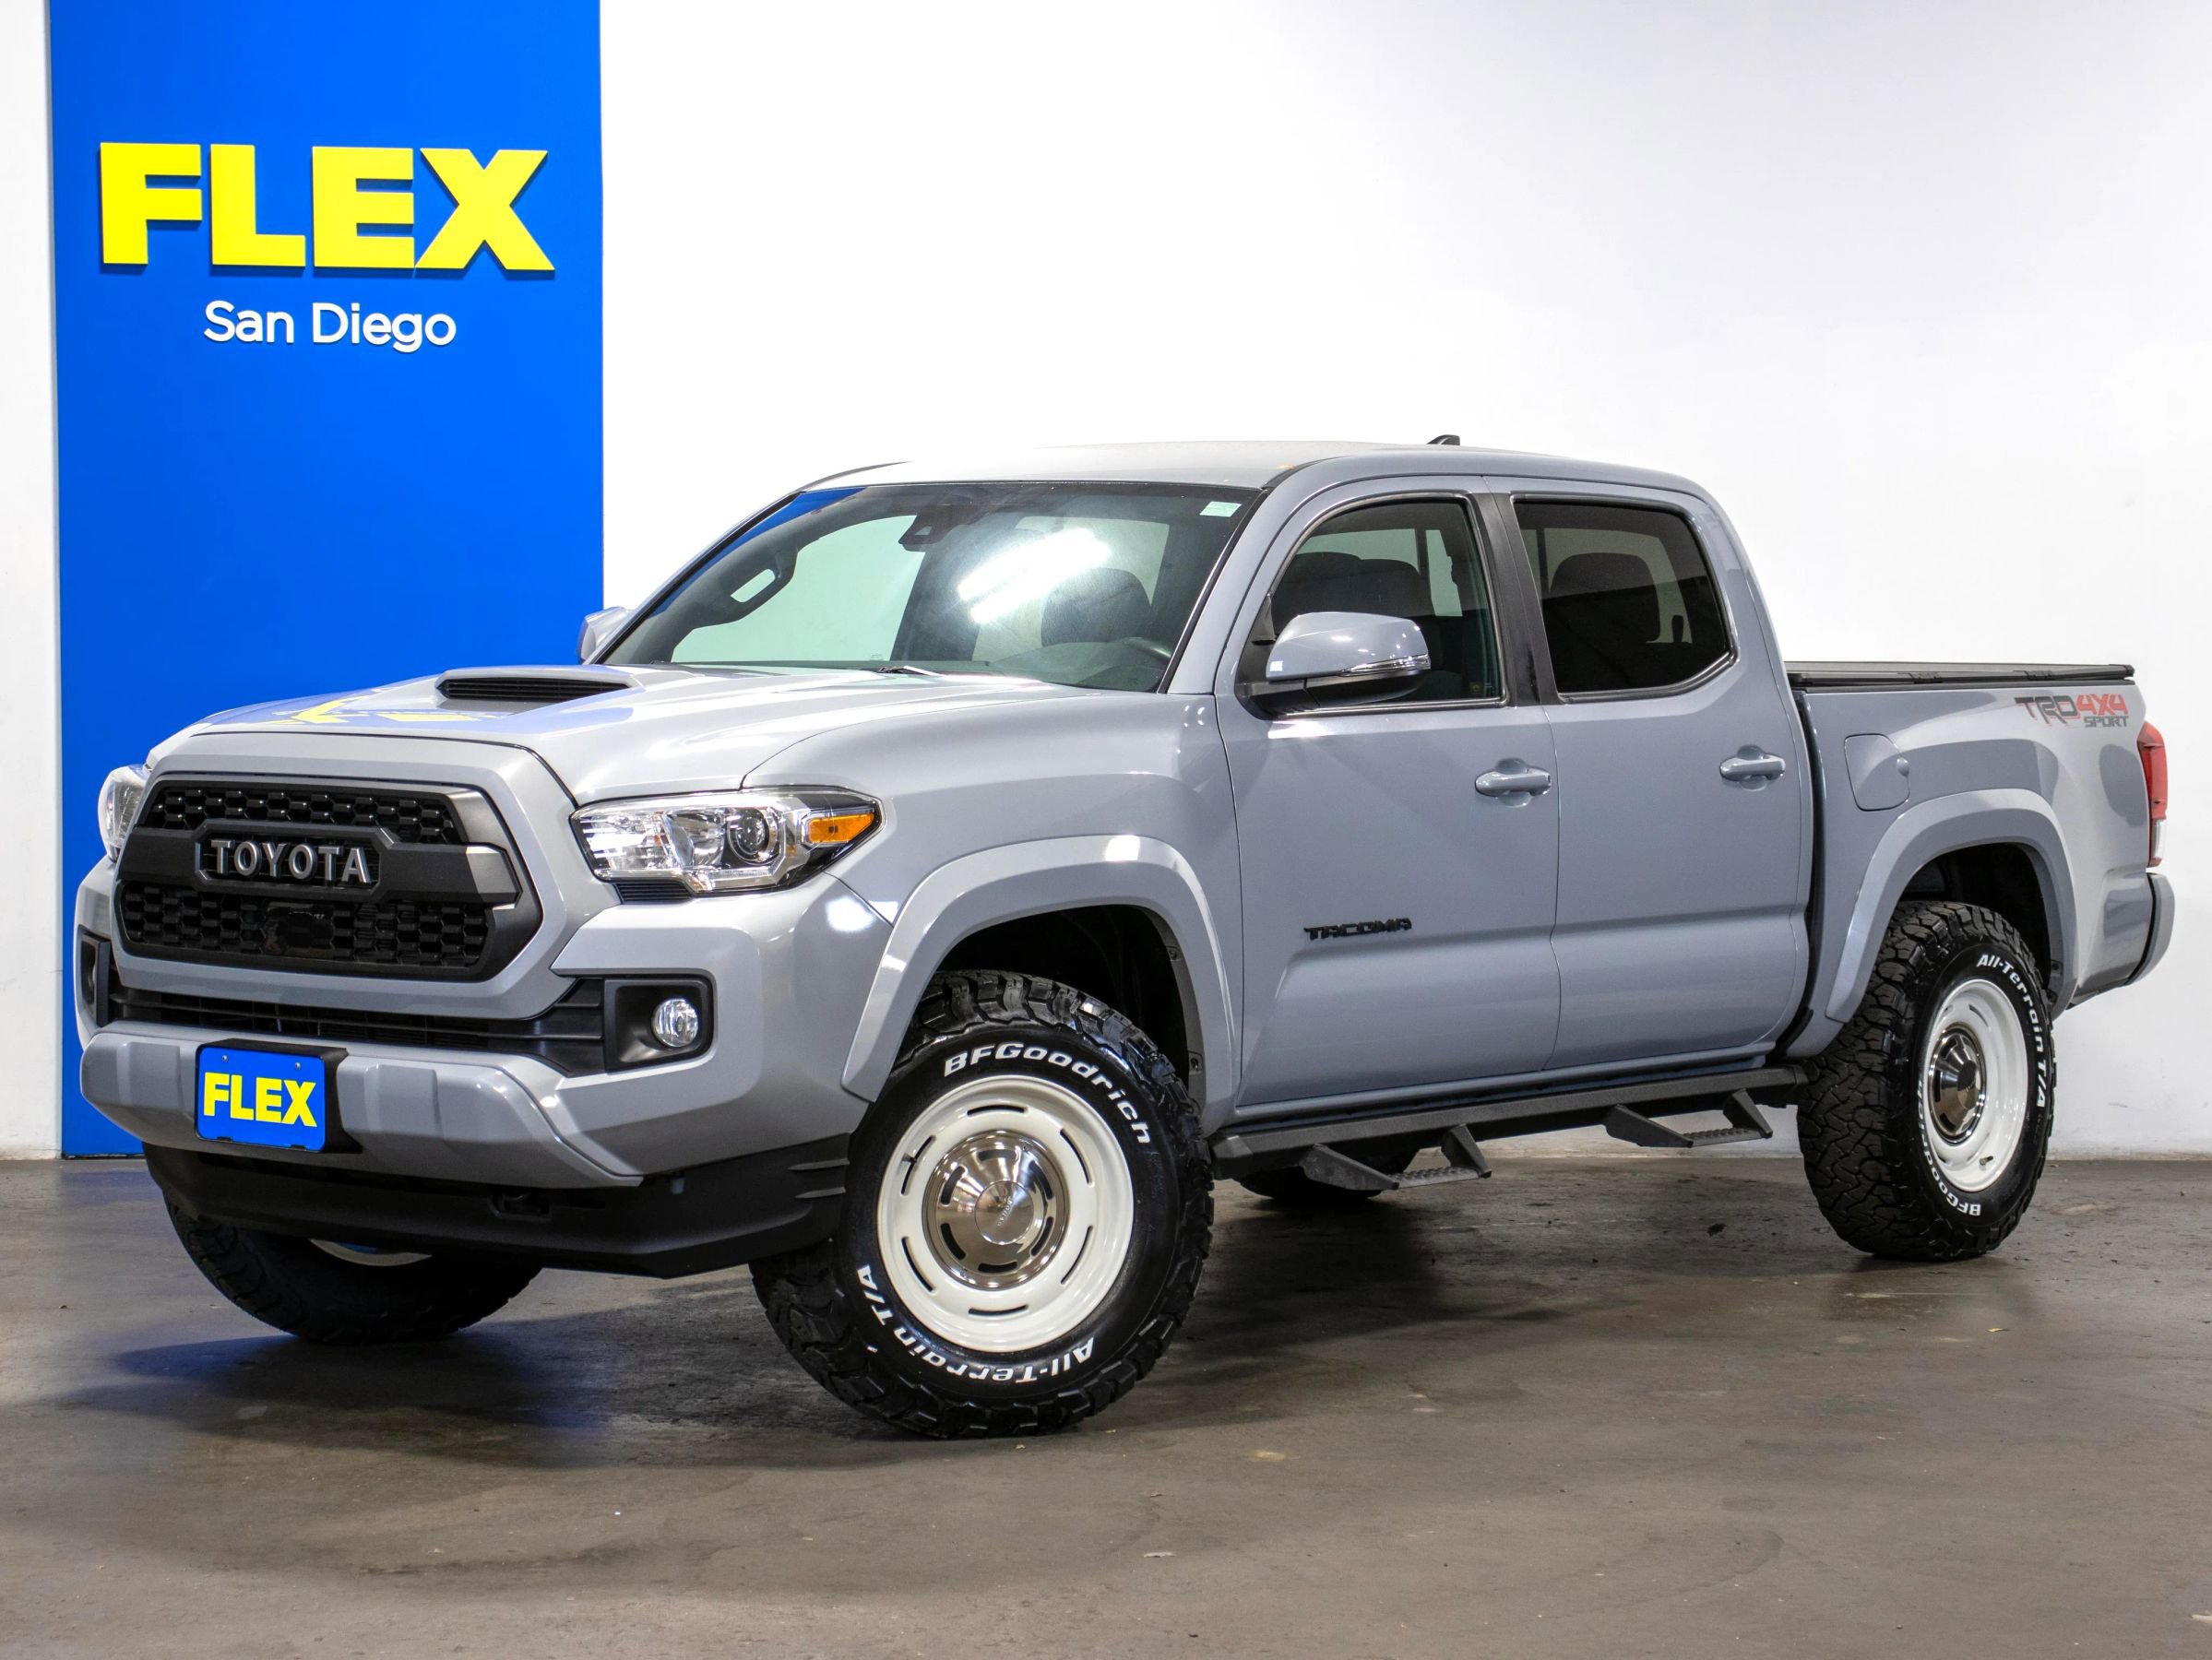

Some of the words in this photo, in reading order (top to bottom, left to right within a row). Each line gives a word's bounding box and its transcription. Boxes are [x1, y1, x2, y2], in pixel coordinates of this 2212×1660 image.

[100, 141, 555, 272] FLEX
[203, 300, 294, 343] San
[312, 302, 457, 352] Diego
[2014, 695, 2081, 726] TRD
[2083, 716, 2129, 728] SPORT
[210, 839, 372, 883] TOYOTA
[1302, 918, 1412, 941] TACOMA
[1976, 954, 2045, 1053] All-Terrain
[2036, 1060, 2047, 1108] T/A
[203, 1072, 318, 1128] FLEX
[944, 1042, 1151, 1144] BFGoodrich
[856, 1264, 894, 1326] T/A
[893, 1326, 1095, 1383] All-Terrain
